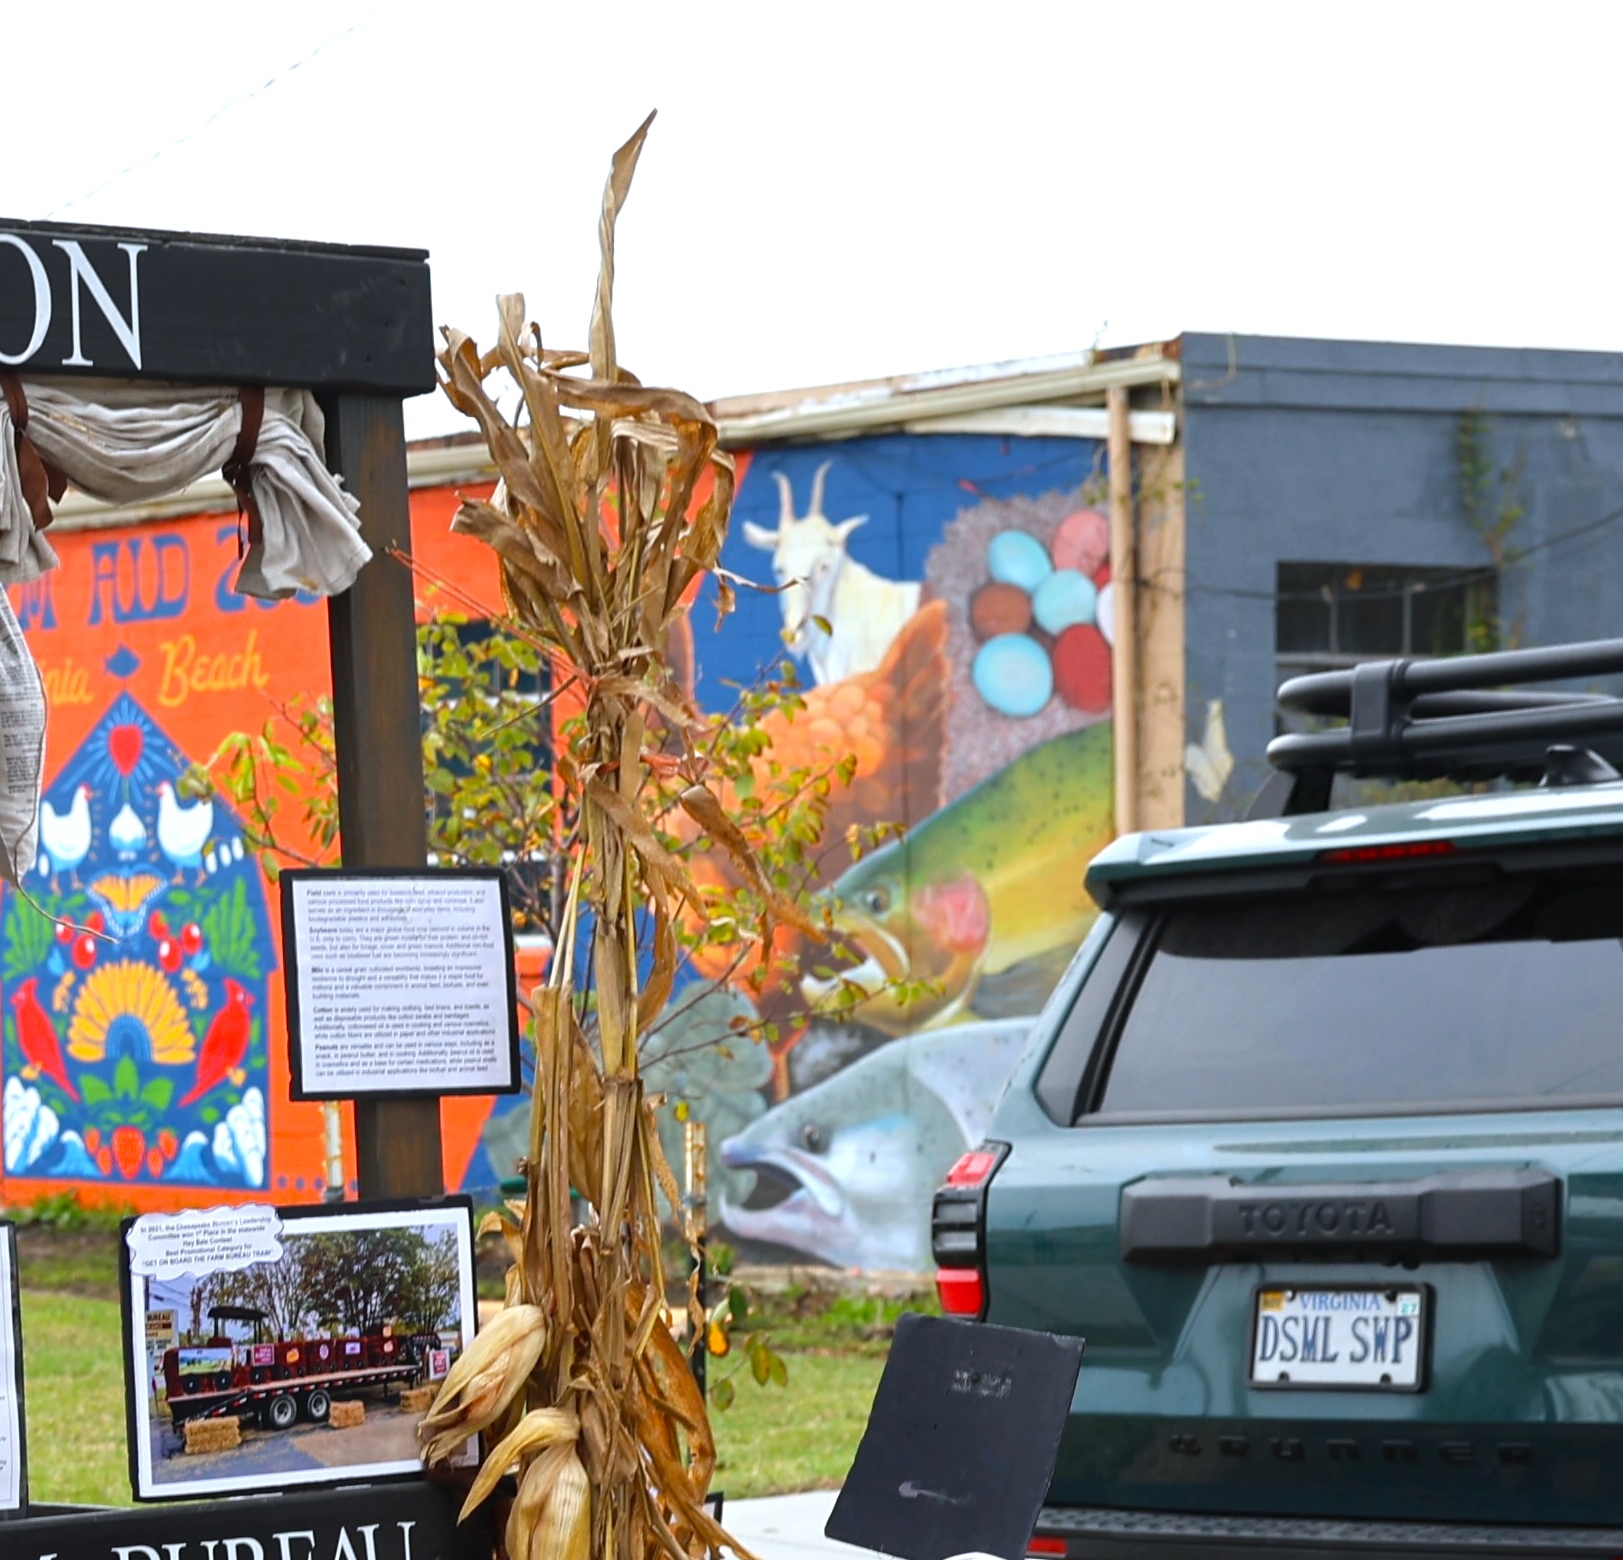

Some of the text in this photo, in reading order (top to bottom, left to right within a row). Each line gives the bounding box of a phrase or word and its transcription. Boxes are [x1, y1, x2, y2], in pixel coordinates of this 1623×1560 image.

[158, 629, 268, 708] Beach
[1239, 1202, 1394, 1236] TOYOTA
[1300, 1293, 1381, 1311] VIRGINIA
[1258, 1315, 1413, 1363] DSML SWP
